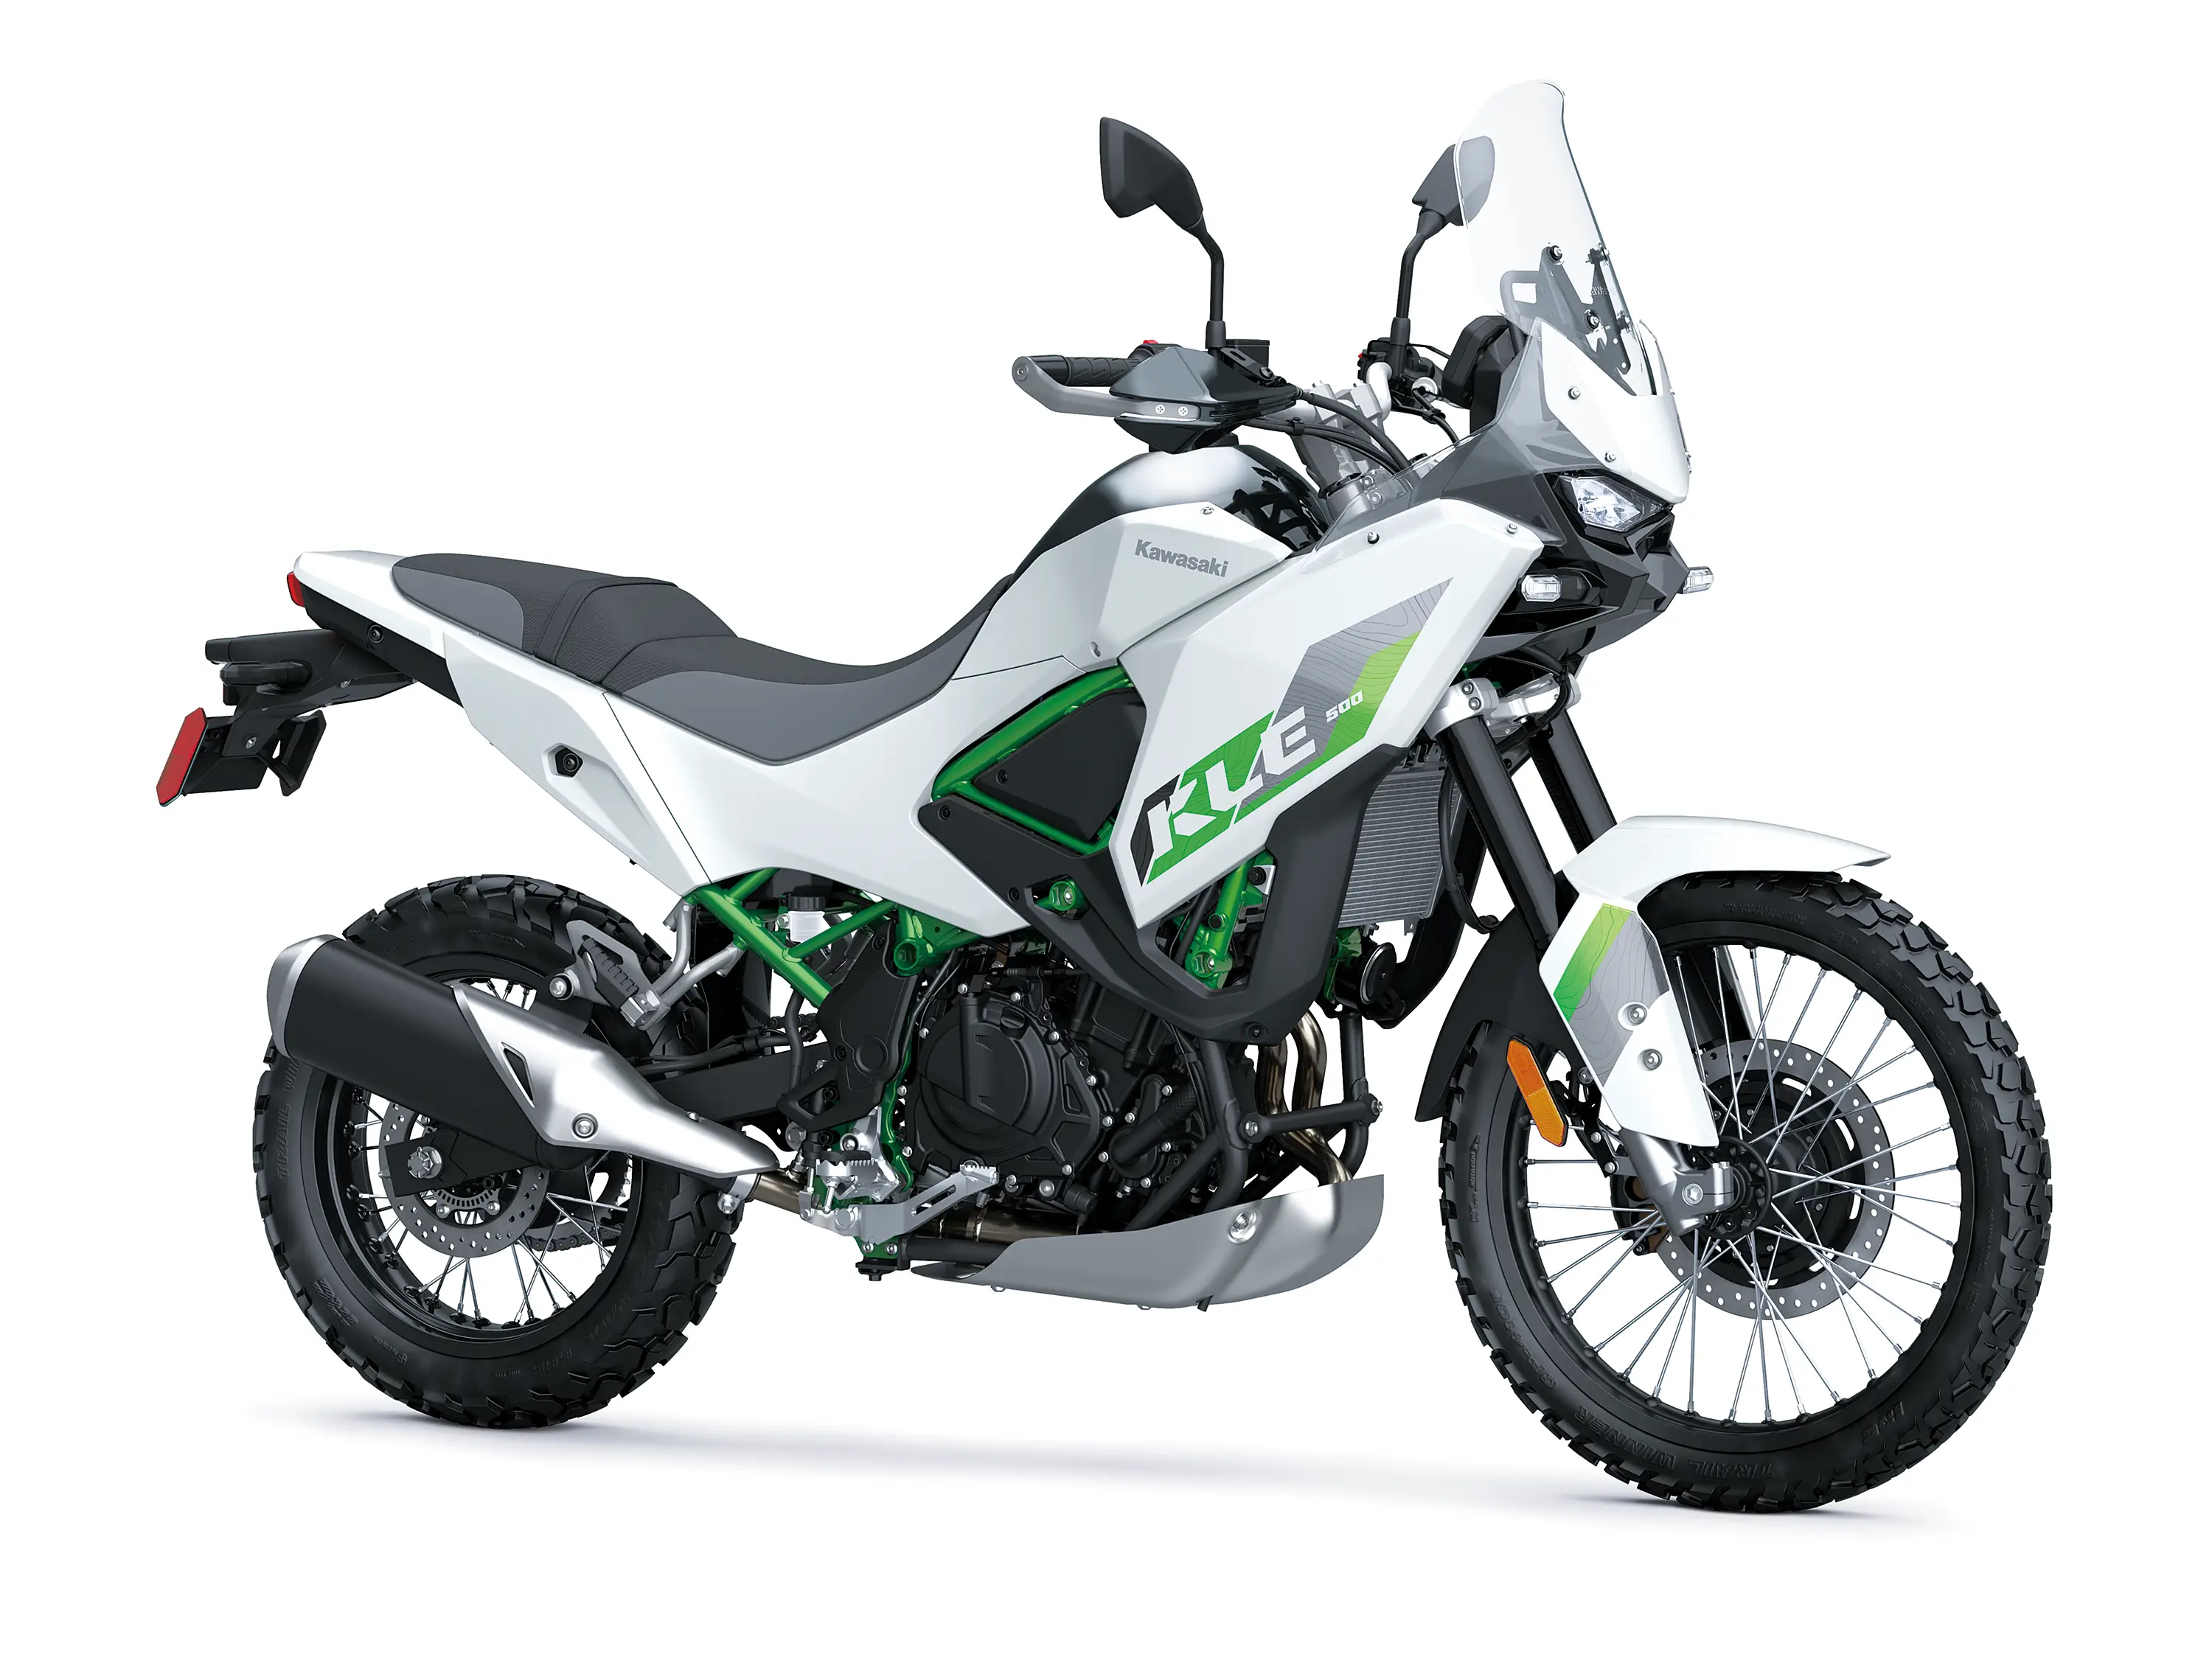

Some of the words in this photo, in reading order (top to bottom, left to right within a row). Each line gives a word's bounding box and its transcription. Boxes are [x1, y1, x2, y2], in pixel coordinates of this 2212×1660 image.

[1135, 539, 1228, 578] Kawasaki
[1147, 706, 1315, 858] KLE
[1326, 690, 1363, 723] 500
[276, 1104, 291, 1179] TRAIL
[1491, 1290, 1557, 1389] GP-410F
[1573, 1405, 1677, 1471] WINNER
[1687, 1459, 1775, 1480] TRAIL
